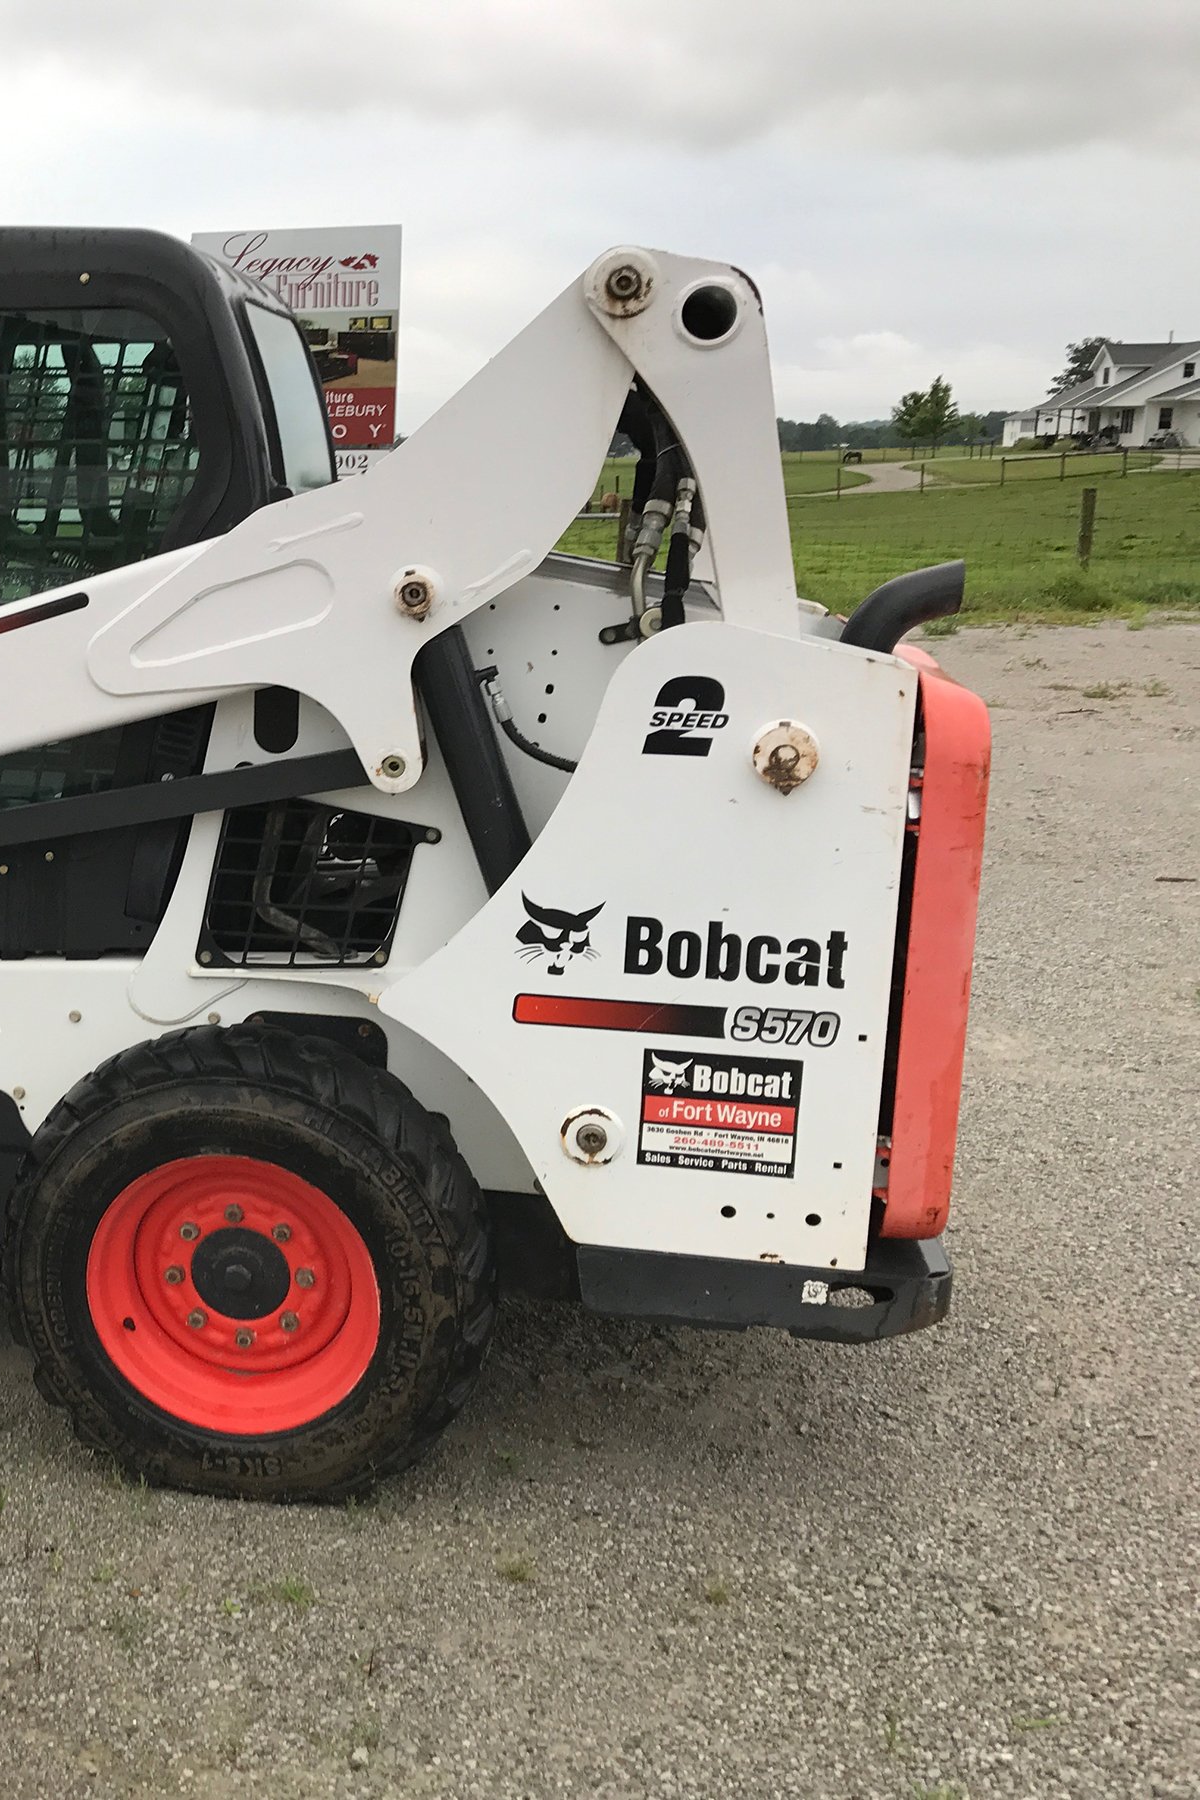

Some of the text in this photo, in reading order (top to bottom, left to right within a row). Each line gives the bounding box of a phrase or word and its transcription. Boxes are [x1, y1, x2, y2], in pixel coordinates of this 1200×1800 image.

[223, 232, 336, 290] Legacy
[275, 272, 380, 309] Furniture
[642, 675, 726, 757] 2
[649, 711, 730, 730] SPEED
[623, 915, 848, 989] Bobcat
[729, 1005, 841, 1048] S570
[692, 1064, 793, 1100] Bobcat
[658, 1100, 782, 1129] of Fort Wayne
[665, 1127, 692, 1136] Goshen
[645, 1152, 787, 1175] Sales Service Parts Rental
